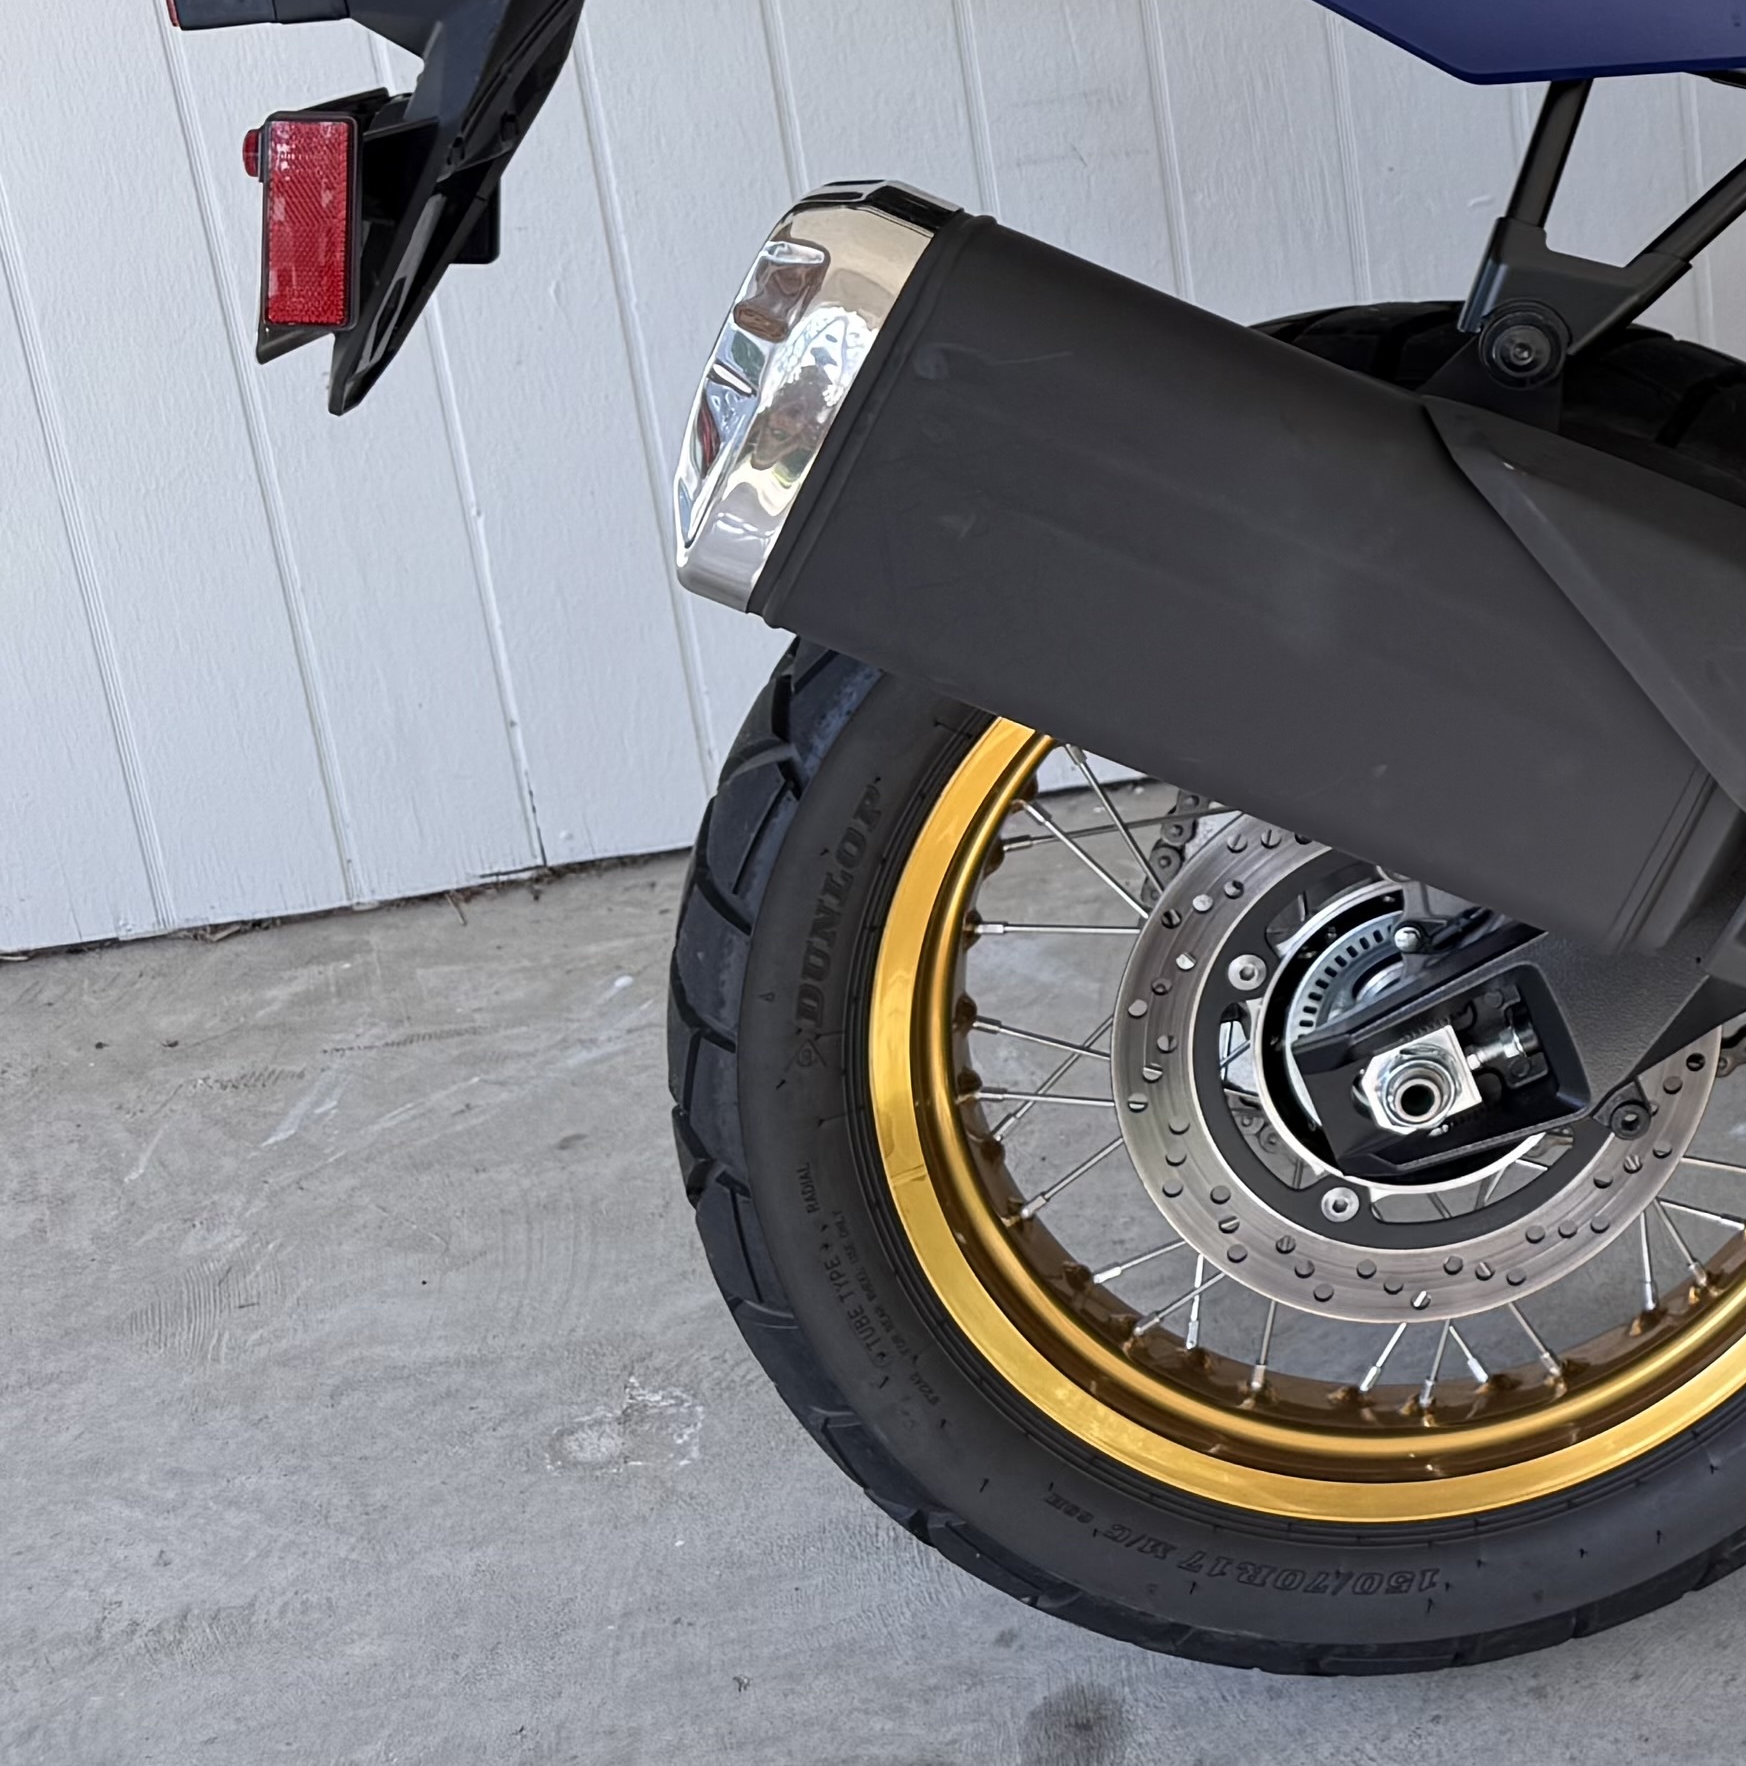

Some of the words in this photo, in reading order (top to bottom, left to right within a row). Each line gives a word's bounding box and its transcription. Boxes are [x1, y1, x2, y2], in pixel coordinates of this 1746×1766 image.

[794, 784, 882, 1029] DUNLOP
[796, 1162, 819, 1214] RADIAL
[822, 1253, 854, 1304] TYPE
[847, 1303, 883, 1353] TUBE
